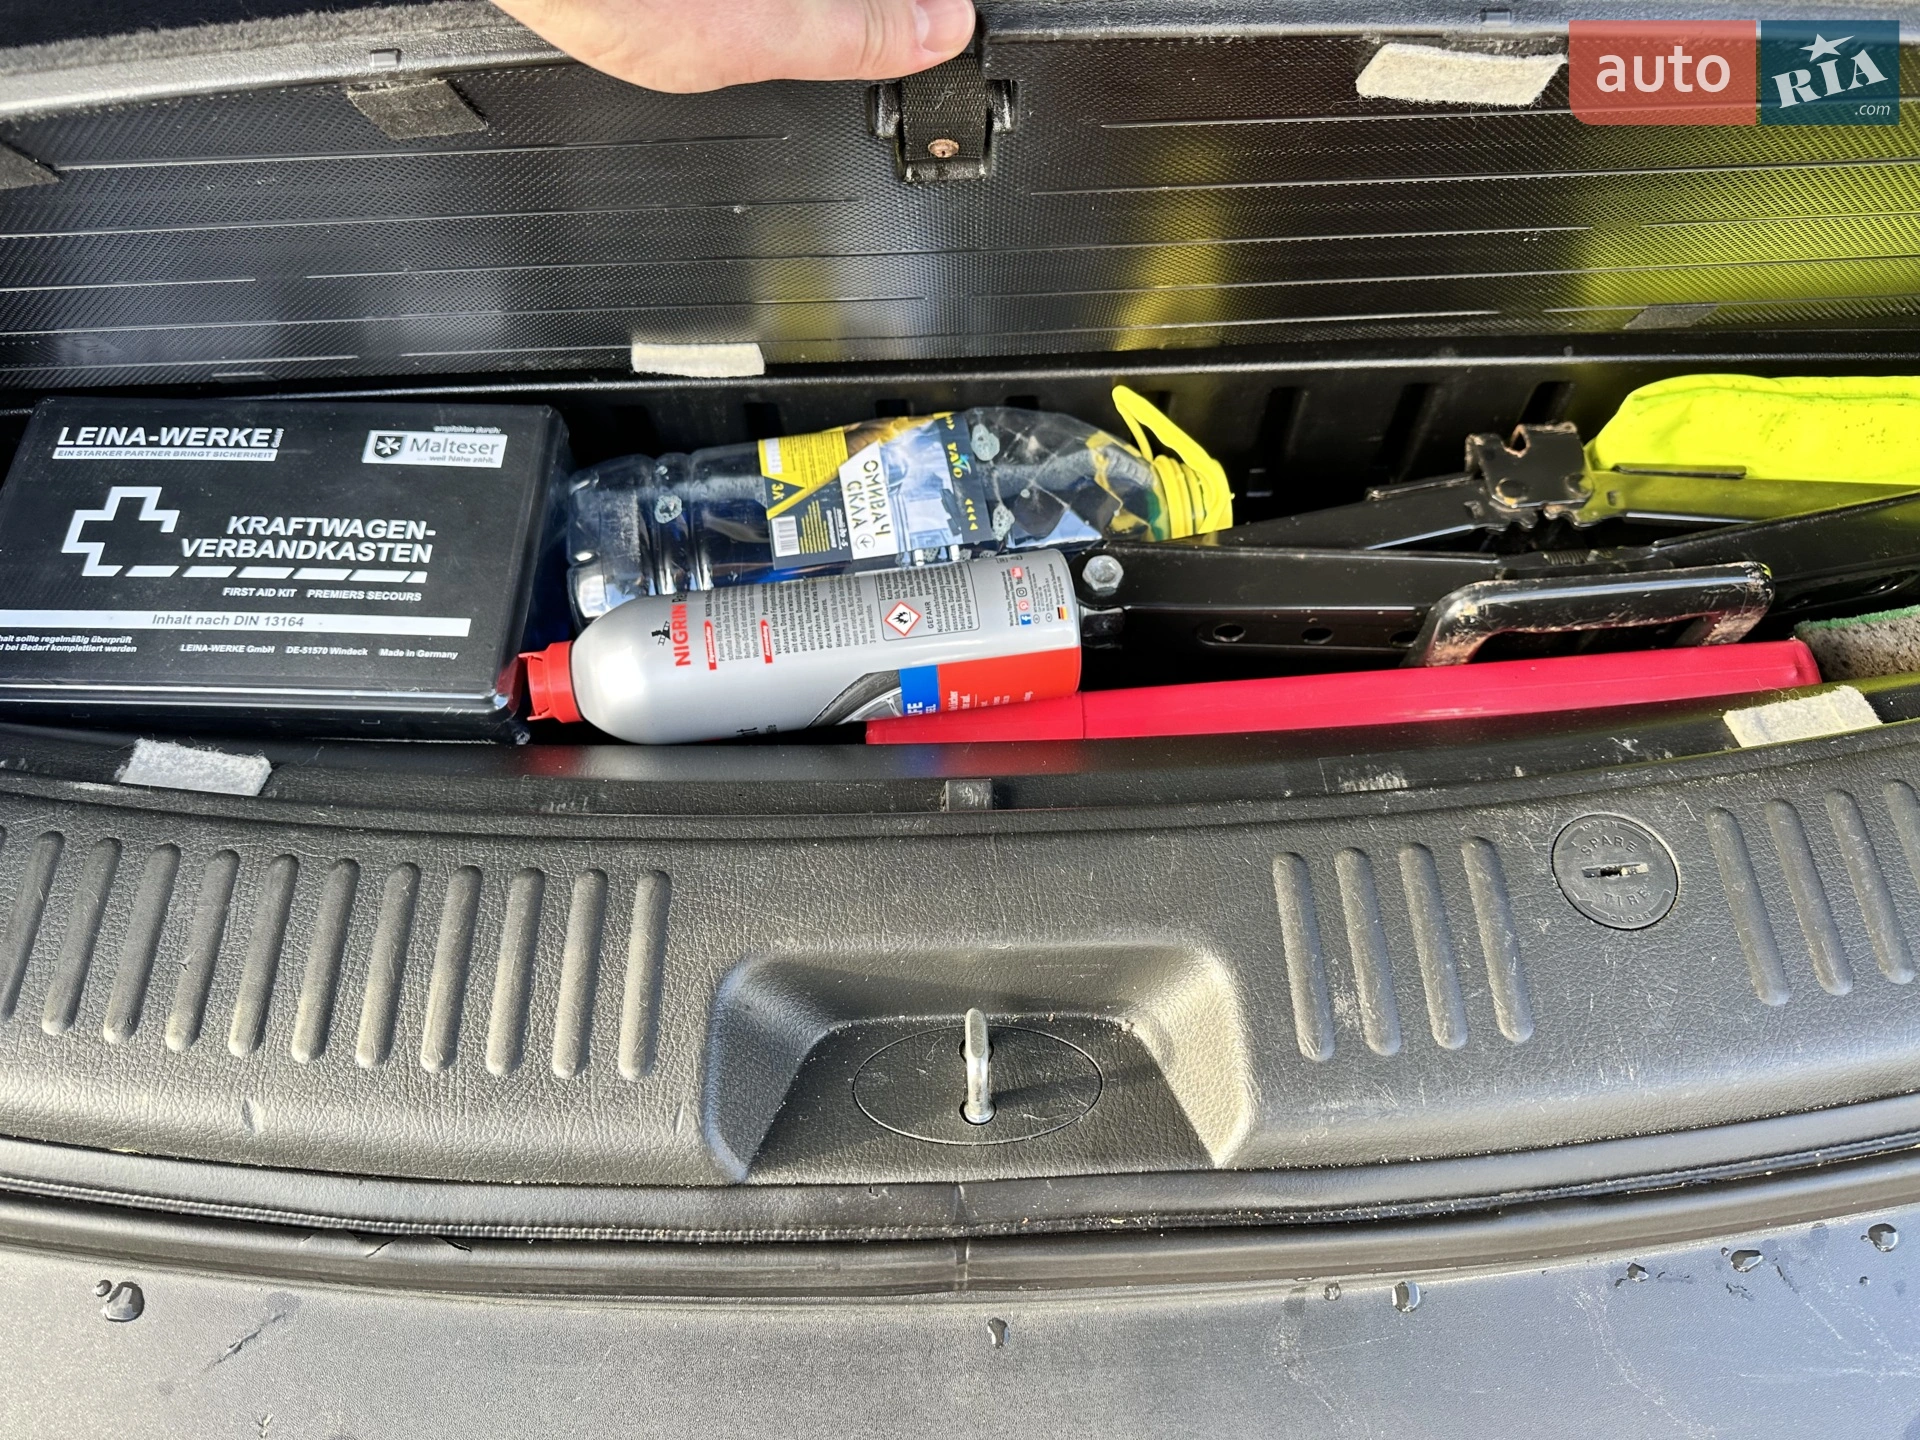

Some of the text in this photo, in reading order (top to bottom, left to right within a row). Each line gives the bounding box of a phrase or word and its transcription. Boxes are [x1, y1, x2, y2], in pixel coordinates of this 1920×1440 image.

[57, 426, 274, 448] LEINA-WERKE
[410, 437, 499, 455] Malteser
[212, 451, 274, 459] SICHERHEIT
[847, 481, 867, 529] СКЛА
[864, 460, 890, 536] ОМИВАЧ
[226, 516, 437, 540] KRAFTWAGEN-
[181, 538, 433, 564] VERBANDKASTEN
[222, 587, 298, 598] FIRST AID KIT
[306, 589, 422, 602] PREMIERS SECOURS
[152, 614, 305, 627] Inhalt nach DIN 13164
[788, 613, 796, 631] Händen
[924, 601, 934, 629] GEFAHR
[965, 615, 973, 629] Kann
[797, 613, 807, 651] aufschrauben.
[814, 613, 824, 649] weiterfahren.
[858, 616, 867, 633] Reifen.
[935, 619, 943, 632] Nicht
[15, 635, 39, 643] sollte
[40, 635, 90, 645] regelmäßig
[91, 636, 132, 645] überprüft
[672, 604, 691, 666] NIGRIN
[751, 626, 759, 658] Weiterfahren
[782, 627, 790, 653] ablassen.
[807, 624, 815, 650] einfüllen.
[824, 633, 832, 648] druck
[834, 624, 843, 648] Hinweis:
[860, 634, 868, 644] tem
[868, 629, 876, 639] mm
[5, 643, 19, 651] bei
[50, 644, 104, 653] komplettiert
[104, 645, 138, 653] werden
[180, 644, 275, 653] LEINA-WERKE GmbH
[285, 646, 368, 656] DE-51570 Windeck
[742, 628, 751, 658] Reifen-Dicht
[773, 638, 782, 655] Ventil
[378, 648, 458, 660] Made in Germany
[1580, 820, 1619, 832] OPEN
[1580, 834, 1638, 856] SPARE
[1604, 887, 1651, 906] TIRE
[1609, 910, 1652, 923] CLOSE
